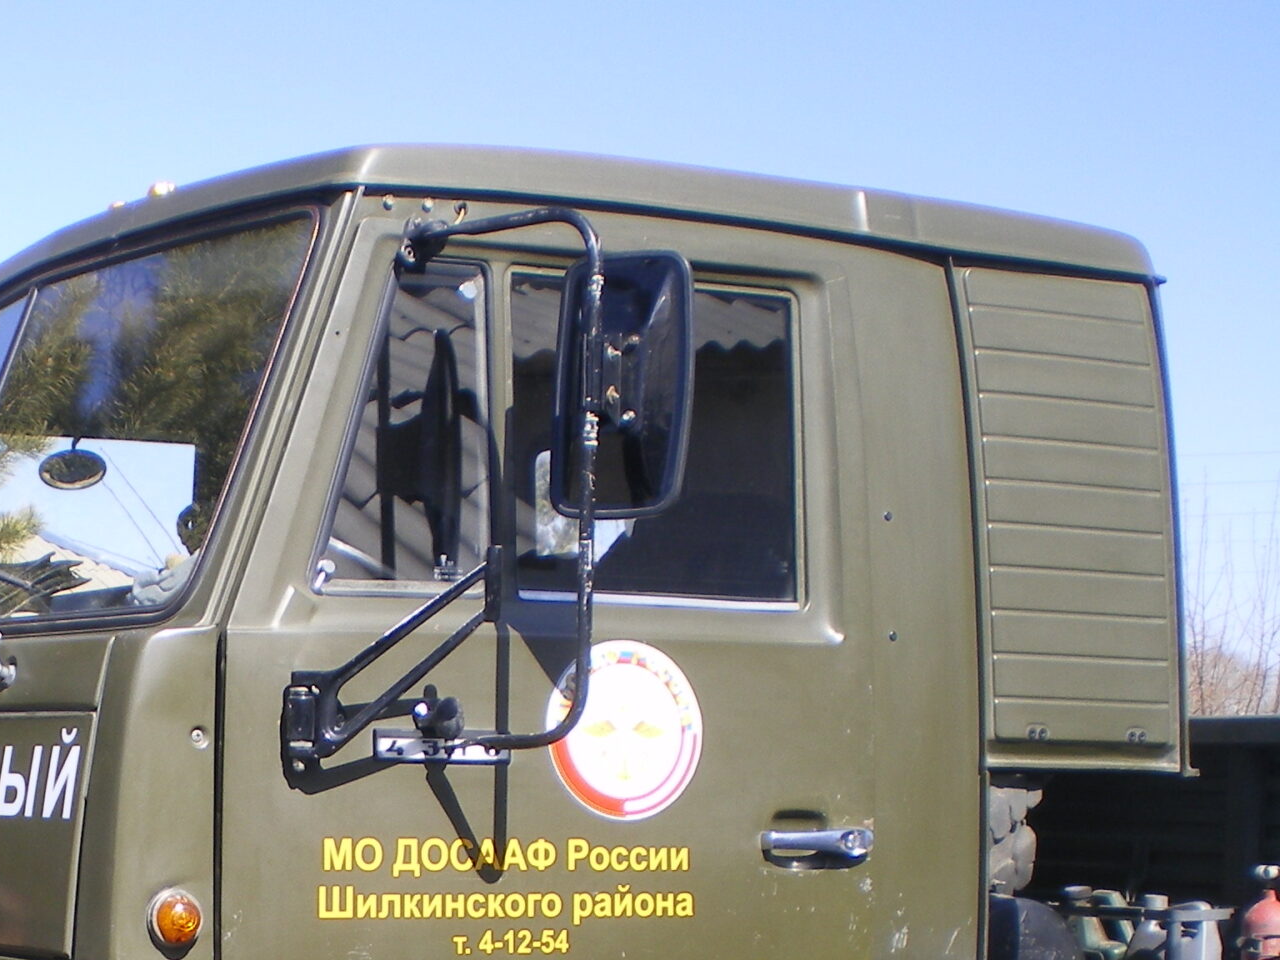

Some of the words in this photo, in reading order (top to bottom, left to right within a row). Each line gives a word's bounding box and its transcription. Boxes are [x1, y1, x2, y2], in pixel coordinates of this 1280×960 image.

[323, 837, 383, 872] МО
[392, 837, 556, 877] ДОСААФ
[567, 838, 690, 872] России
[317, 886, 562, 919] Шилкинского
[573, 884, 694, 925] района
[478, 930, 569, 954] 4-12-54
